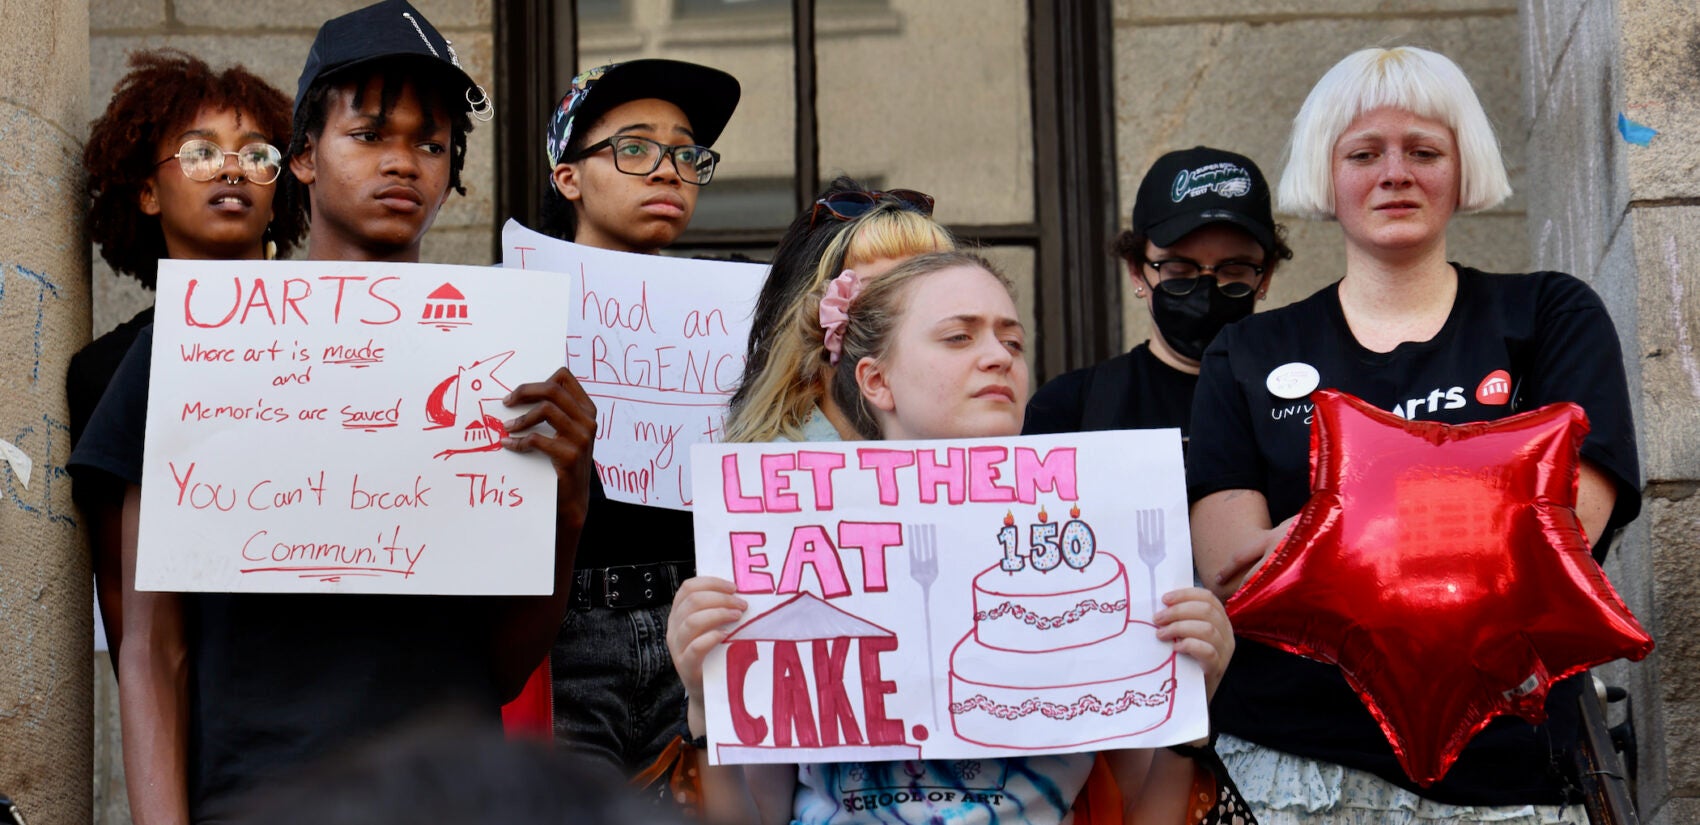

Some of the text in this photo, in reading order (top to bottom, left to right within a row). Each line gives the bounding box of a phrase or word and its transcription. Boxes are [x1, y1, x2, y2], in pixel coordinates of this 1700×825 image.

[184, 275, 402, 329] UARTS
[580, 262, 728, 338] had an
[244, 346, 284, 363] art
[292, 340, 311, 361] is
[323, 339, 384, 363] made
[272, 366, 312, 387] and
[566, 335, 747, 394] ERGENC
[181, 398, 290, 423] Memories
[298, 406, 328, 422] are
[633, 420, 684, 468] my
[351, 475, 432, 511] break
[455, 472, 523, 509] This
[594, 459, 661, 505] rning!
[722, 450, 845, 514] LET
[856, 446, 1079, 506] THEM
[729, 520, 904, 600] EAT
[996, 519, 1098, 573] 150
[726, 636, 930, 749] CAKE.
[842, 791, 1004, 813] SCHOOL OF ART
